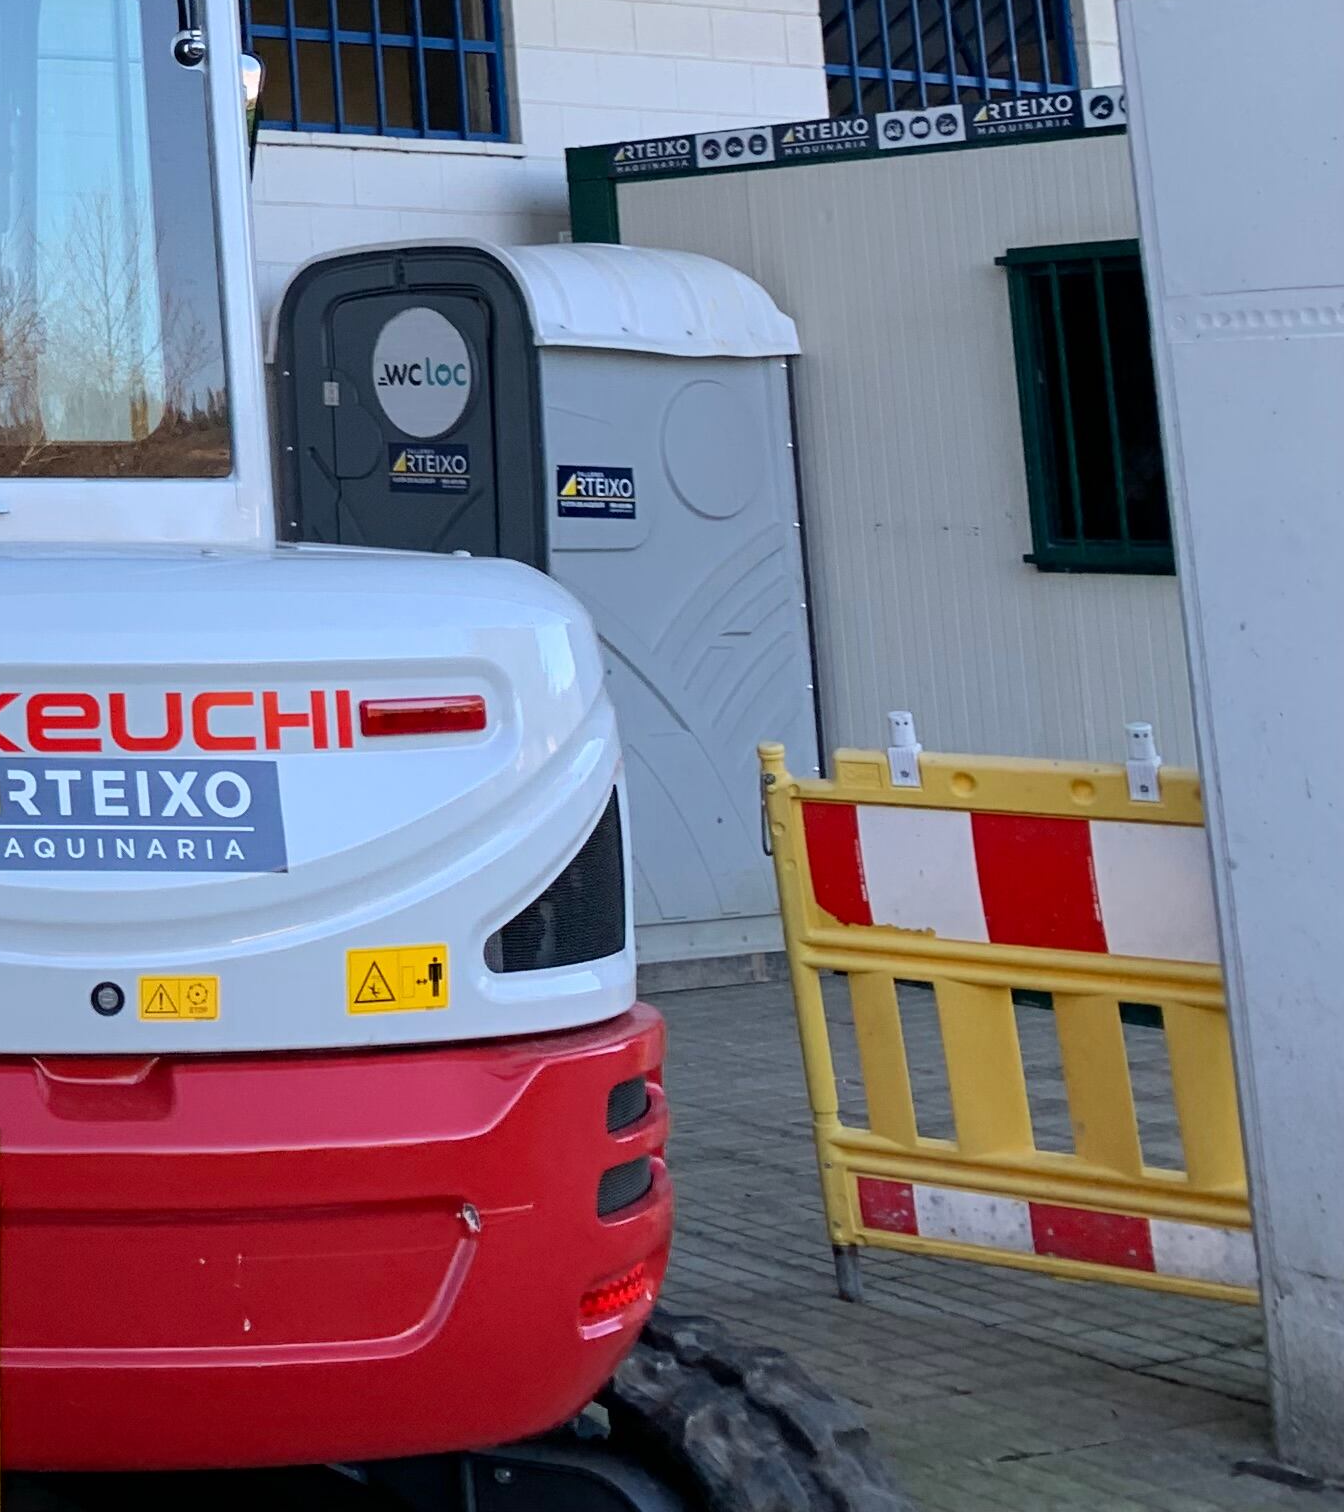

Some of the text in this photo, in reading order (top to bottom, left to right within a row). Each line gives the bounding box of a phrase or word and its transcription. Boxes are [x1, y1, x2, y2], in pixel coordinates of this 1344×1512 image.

[972, 94, 1072, 122] ARTEIXO
[780, 118, 869, 143] ARTEIXO
[977, 118, 1071, 135] MAQUINARIA
[614, 139, 690, 161] ARTEIXO
[785, 140, 867, 155] MAQUINARIA
[393, 451, 467, 474] ARTEIXO
[560, 474, 633, 497] ARTEIXO
